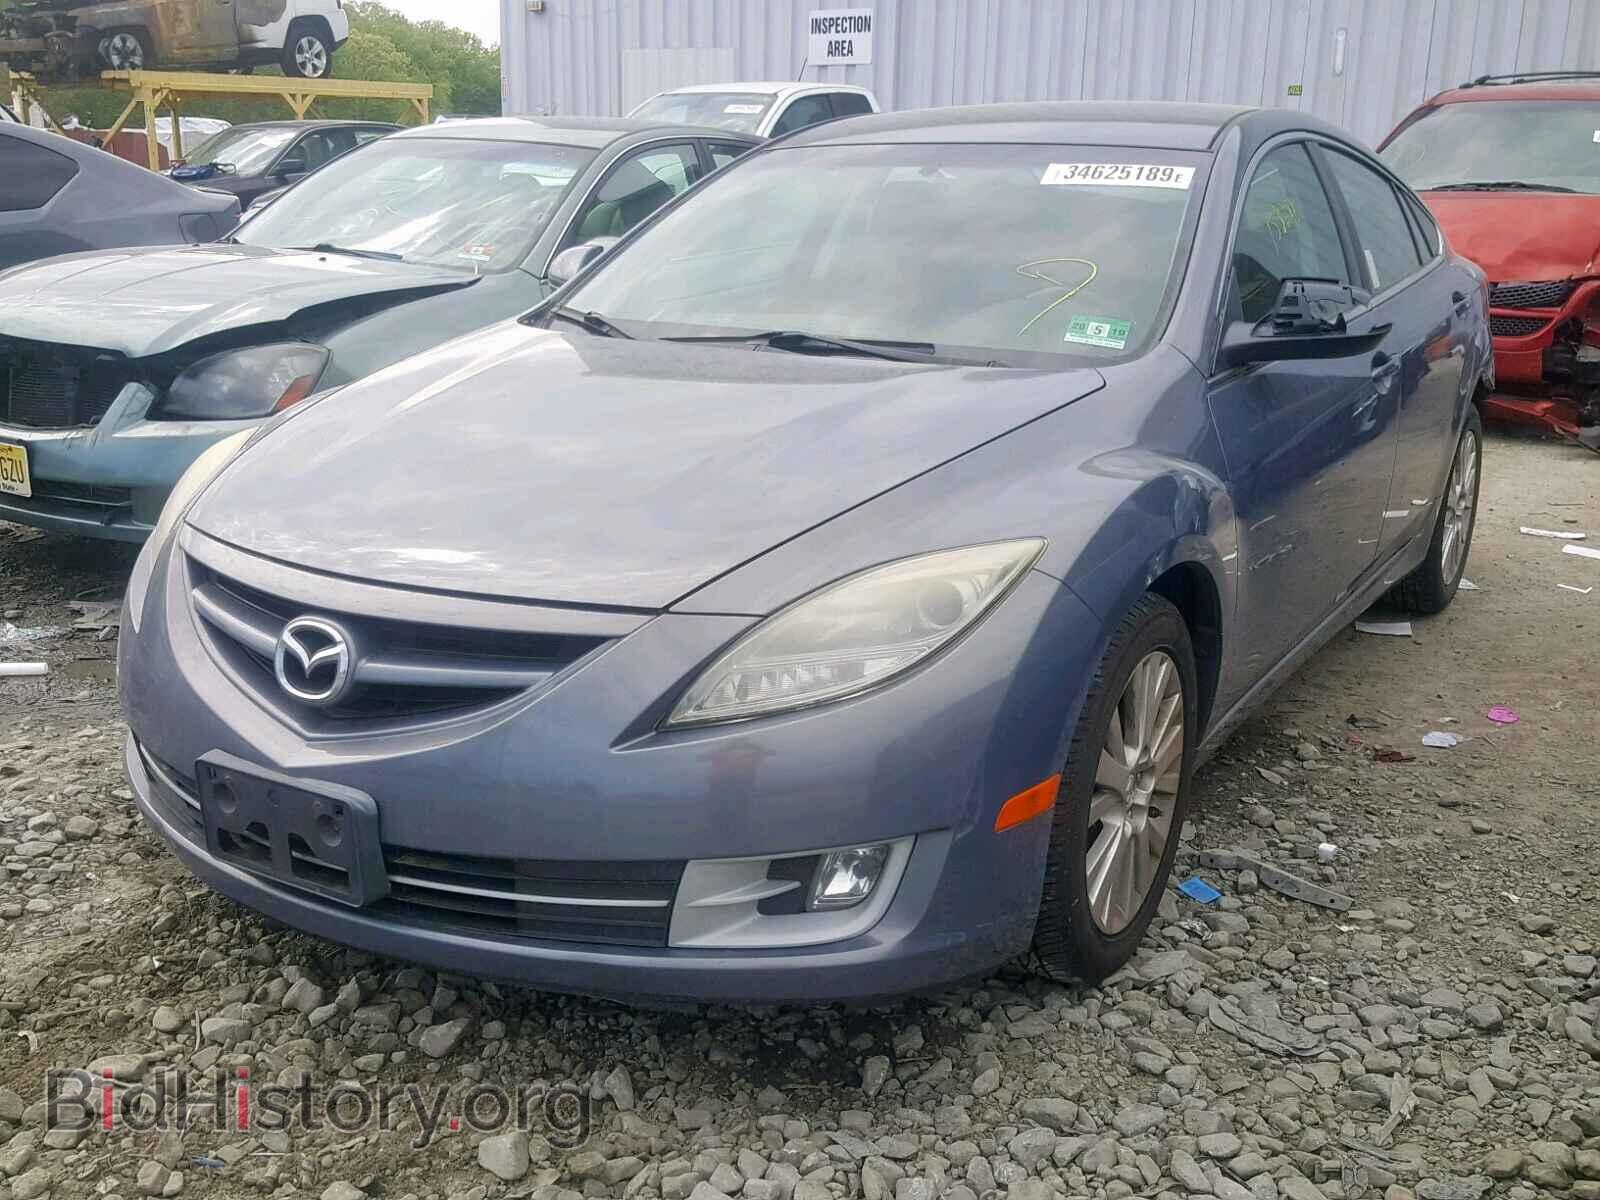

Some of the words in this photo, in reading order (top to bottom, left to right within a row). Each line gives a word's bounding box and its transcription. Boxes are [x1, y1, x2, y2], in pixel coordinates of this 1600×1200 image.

[811, 15, 871, 35] INSPECTION
[827, 39, 854, 57] AREA
[1093, 324, 1104, 335] 5
